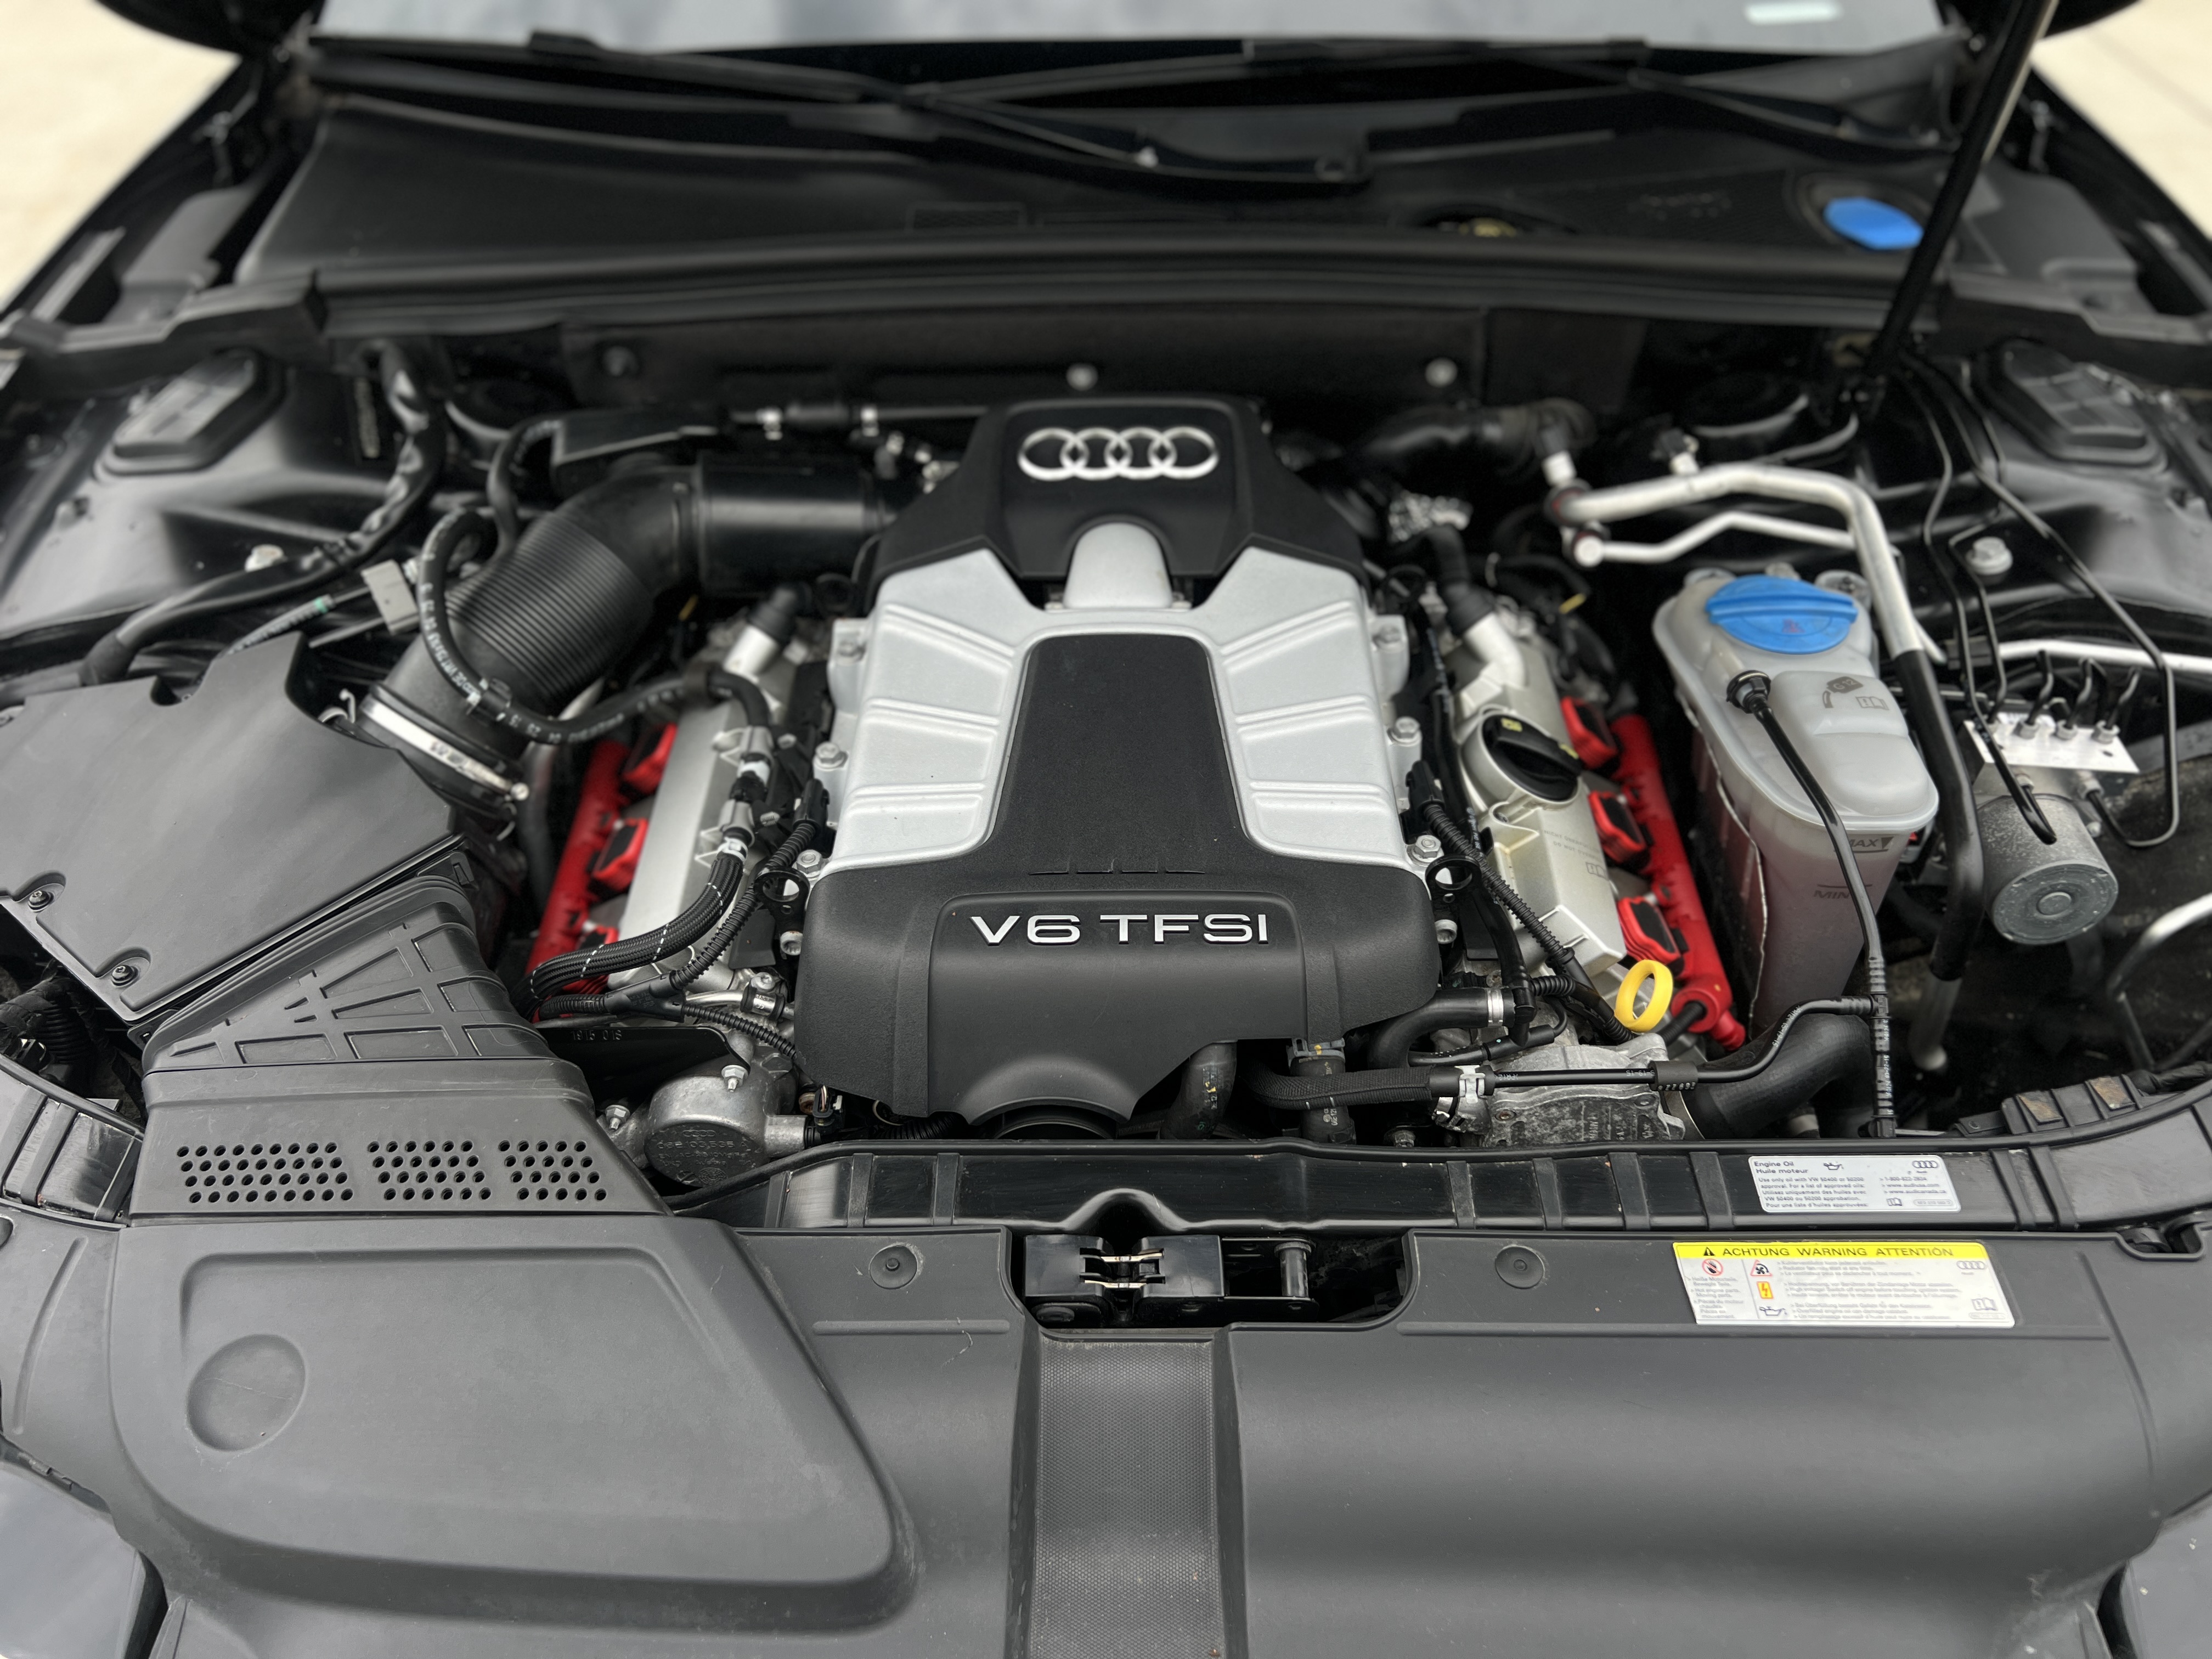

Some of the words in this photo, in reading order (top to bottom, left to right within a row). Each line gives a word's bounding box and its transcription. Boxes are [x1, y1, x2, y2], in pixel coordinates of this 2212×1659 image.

[1814, 890, 1851, 899] MIN
[969, 913, 1081, 946] V6
[1099, 913, 1269, 945] TFSI
[1723, 1248, 1790, 1257] ACHTUNG
[1797, 1248, 1868, 1257] WARNING
[1876, 1246, 1954, 1257] ATTENTION
